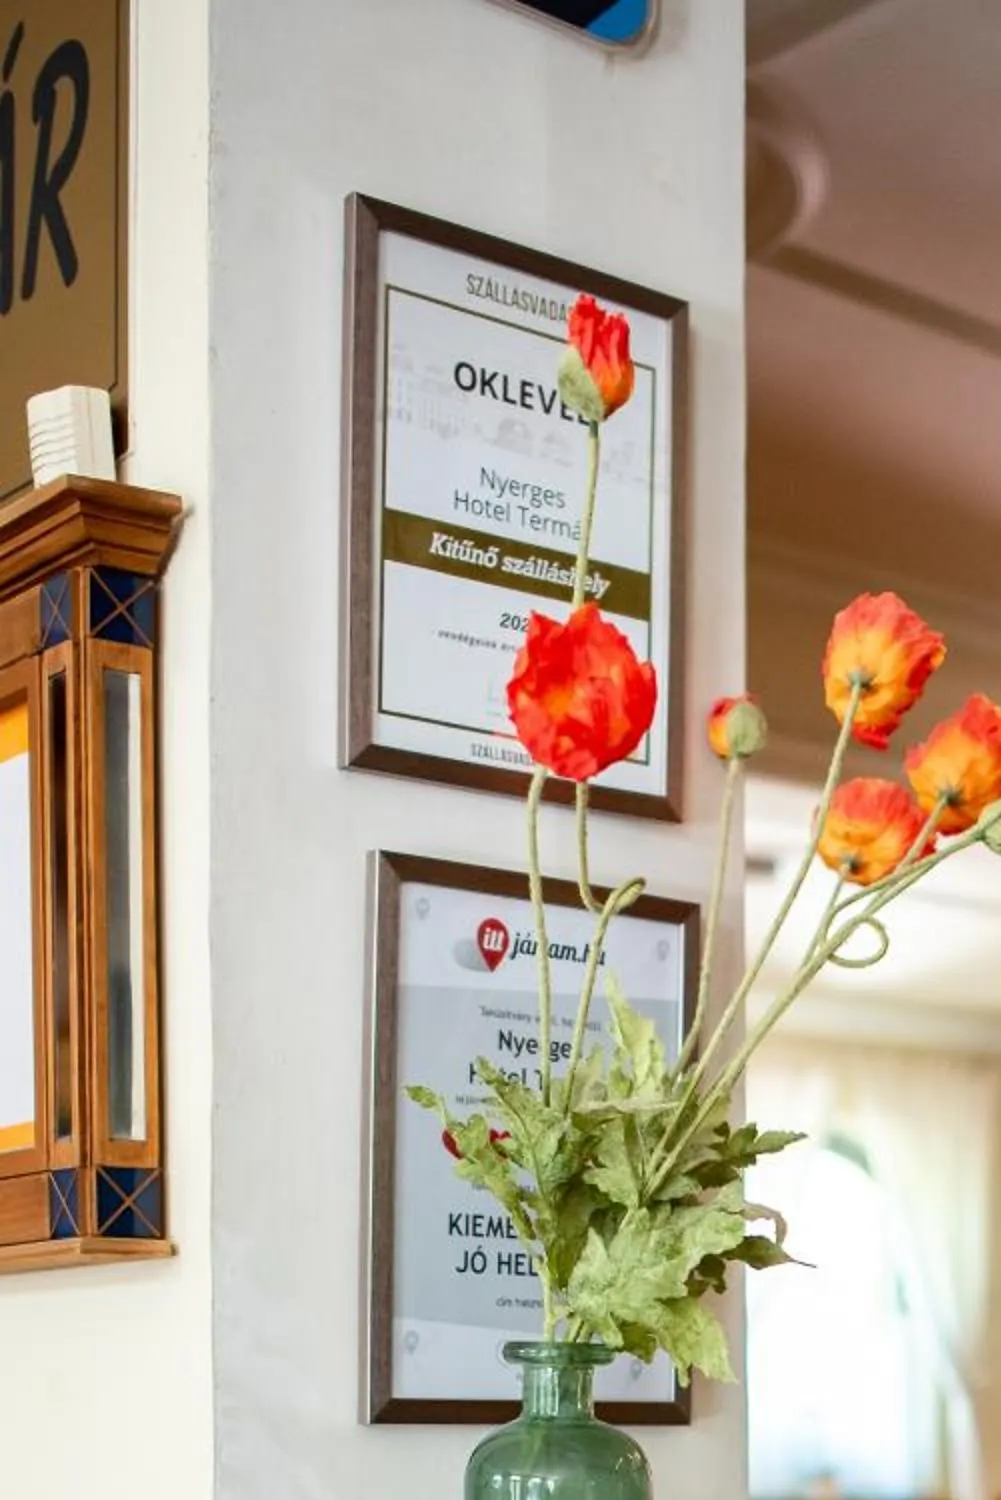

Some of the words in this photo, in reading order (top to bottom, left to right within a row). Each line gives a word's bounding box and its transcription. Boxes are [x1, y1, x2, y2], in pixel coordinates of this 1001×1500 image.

[480, 467, 566, 509] Nyerges
[454, 488, 511, 523] Hotel
[517, 505, 583, 541] Termá
[499, 612, 530, 633] 202
[448, 1211, 519, 1240] KIEME
[455, 1244, 488, 1275] JÓ
[497, 1251, 540, 1277] HEL
